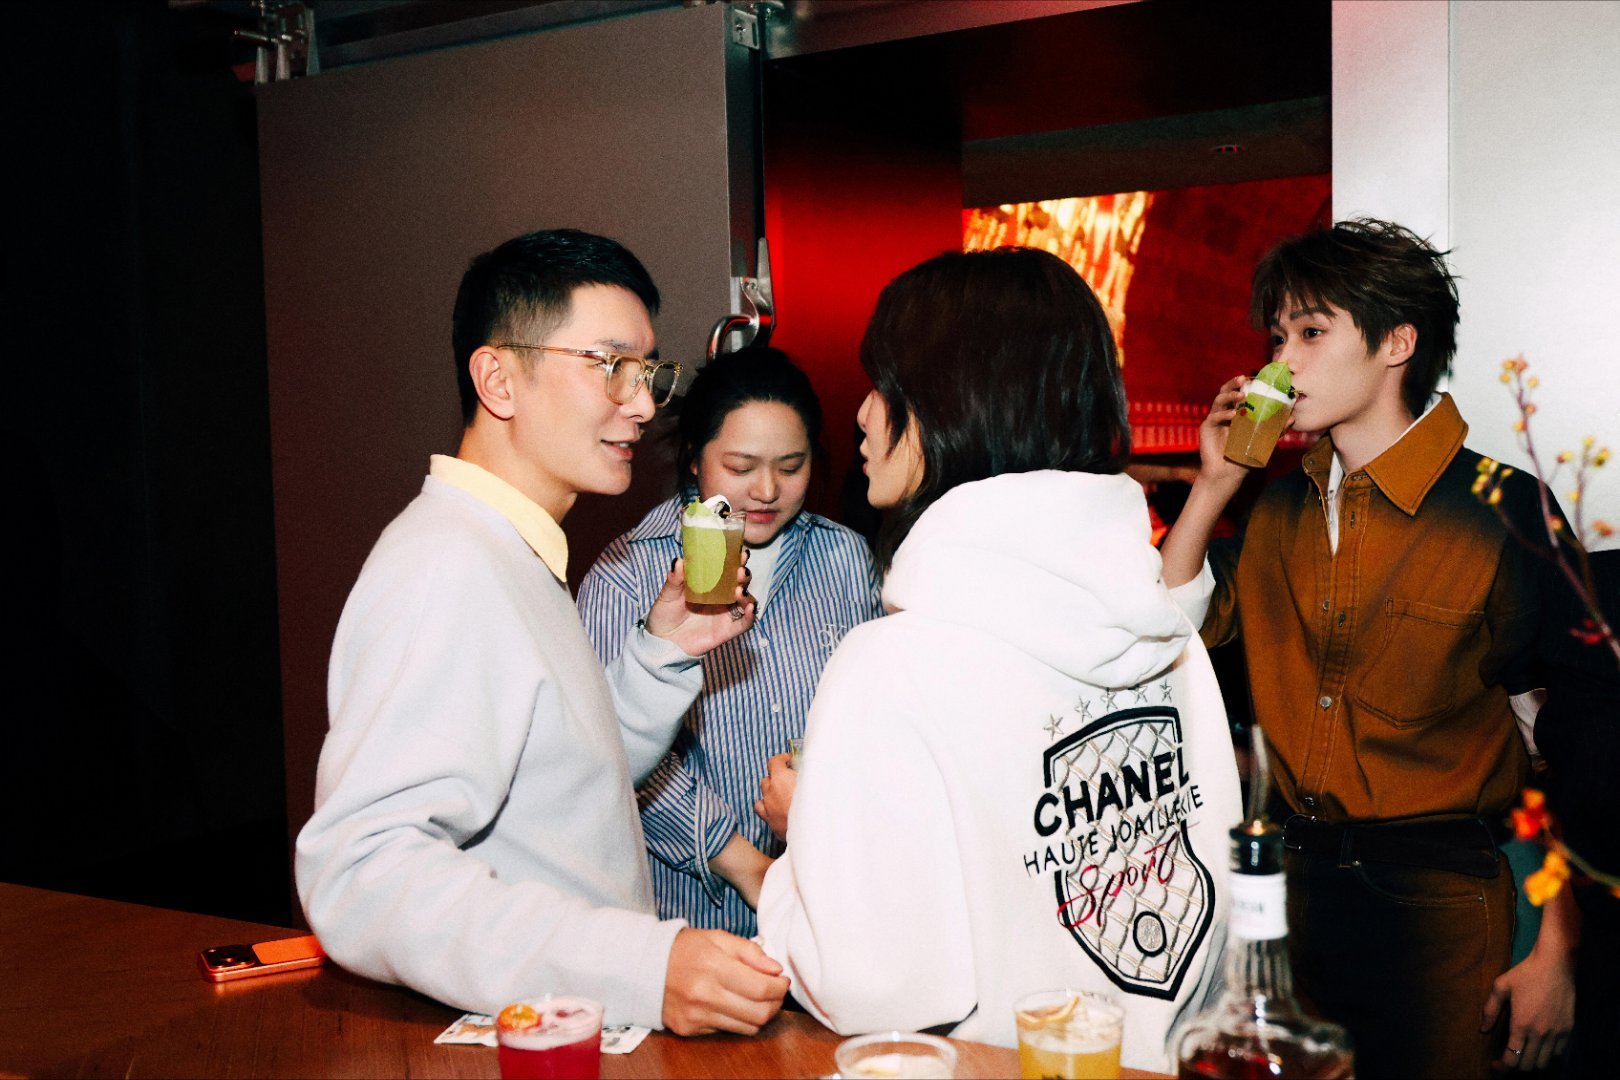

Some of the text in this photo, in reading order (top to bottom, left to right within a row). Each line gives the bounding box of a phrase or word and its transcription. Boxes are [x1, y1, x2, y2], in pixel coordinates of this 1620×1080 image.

[1033, 746, 1189, 837] CHANEL
[1023, 827, 1098, 878] HAUTE
[1057, 822, 1200, 928] Sport
